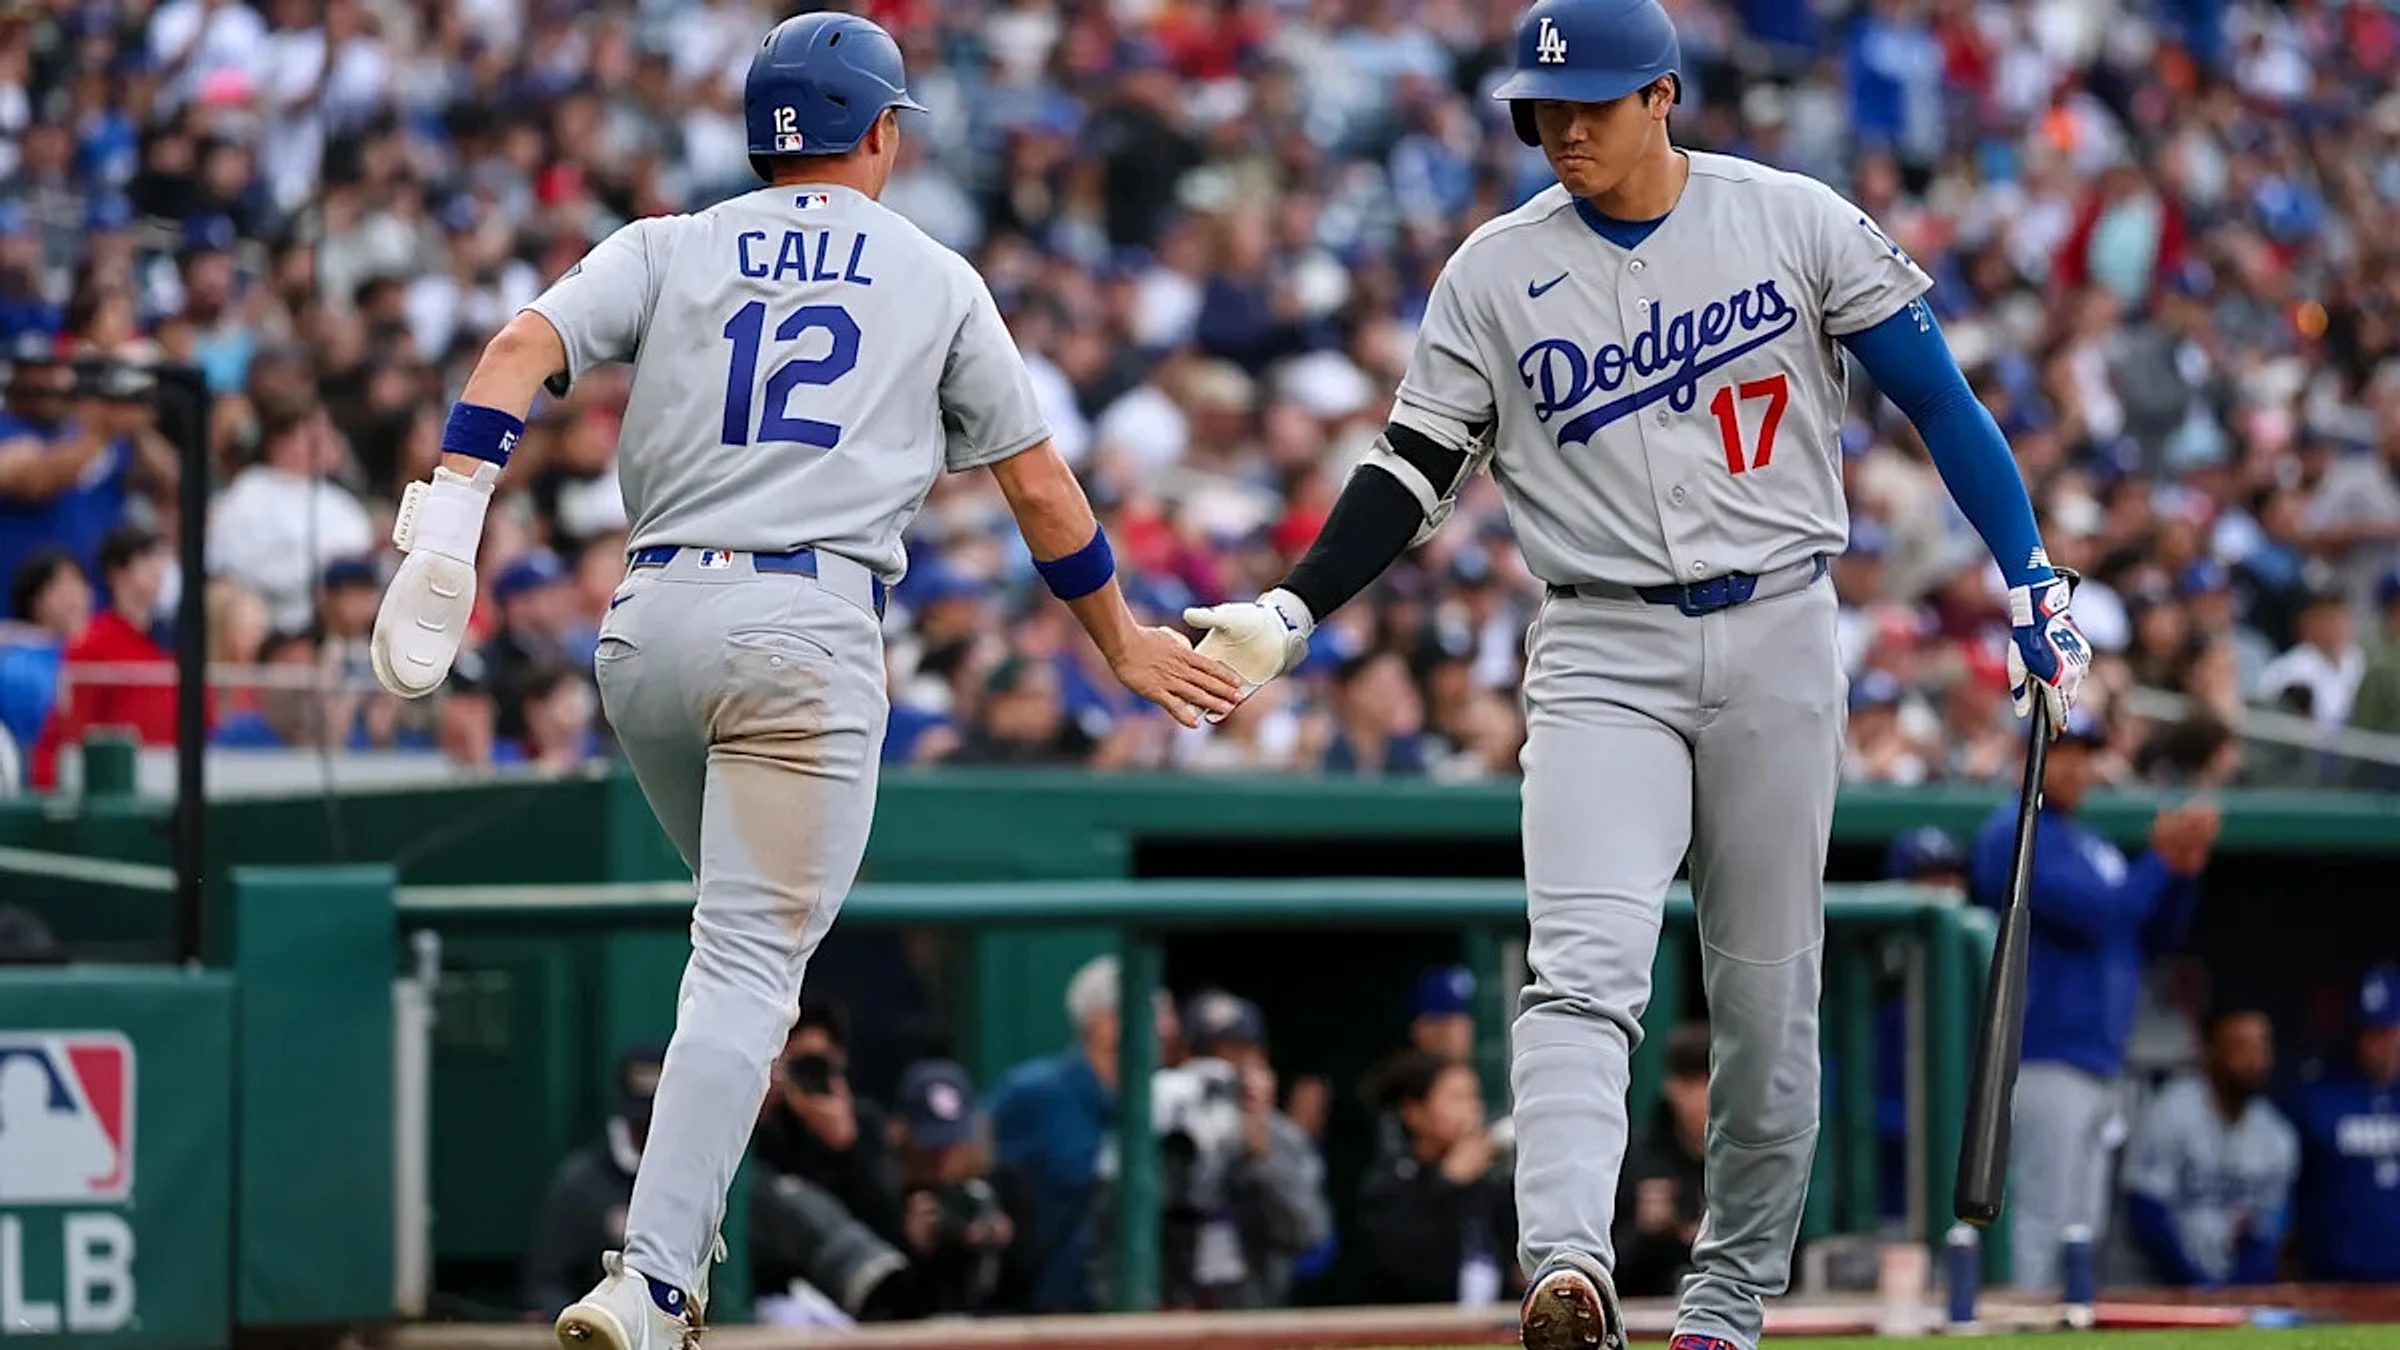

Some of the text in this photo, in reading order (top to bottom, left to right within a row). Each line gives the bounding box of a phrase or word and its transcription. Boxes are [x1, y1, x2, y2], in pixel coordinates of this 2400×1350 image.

[1536, 17, 1567, 63] LA
[773, 106, 798, 133] 12
[738, 230, 872, 285] CALL
[721, 300, 862, 449] 12
[1518, 279, 1797, 449] Dodgers
[1710, 373, 1790, 475] 17
[0, 1212, 136, 1334] LB
